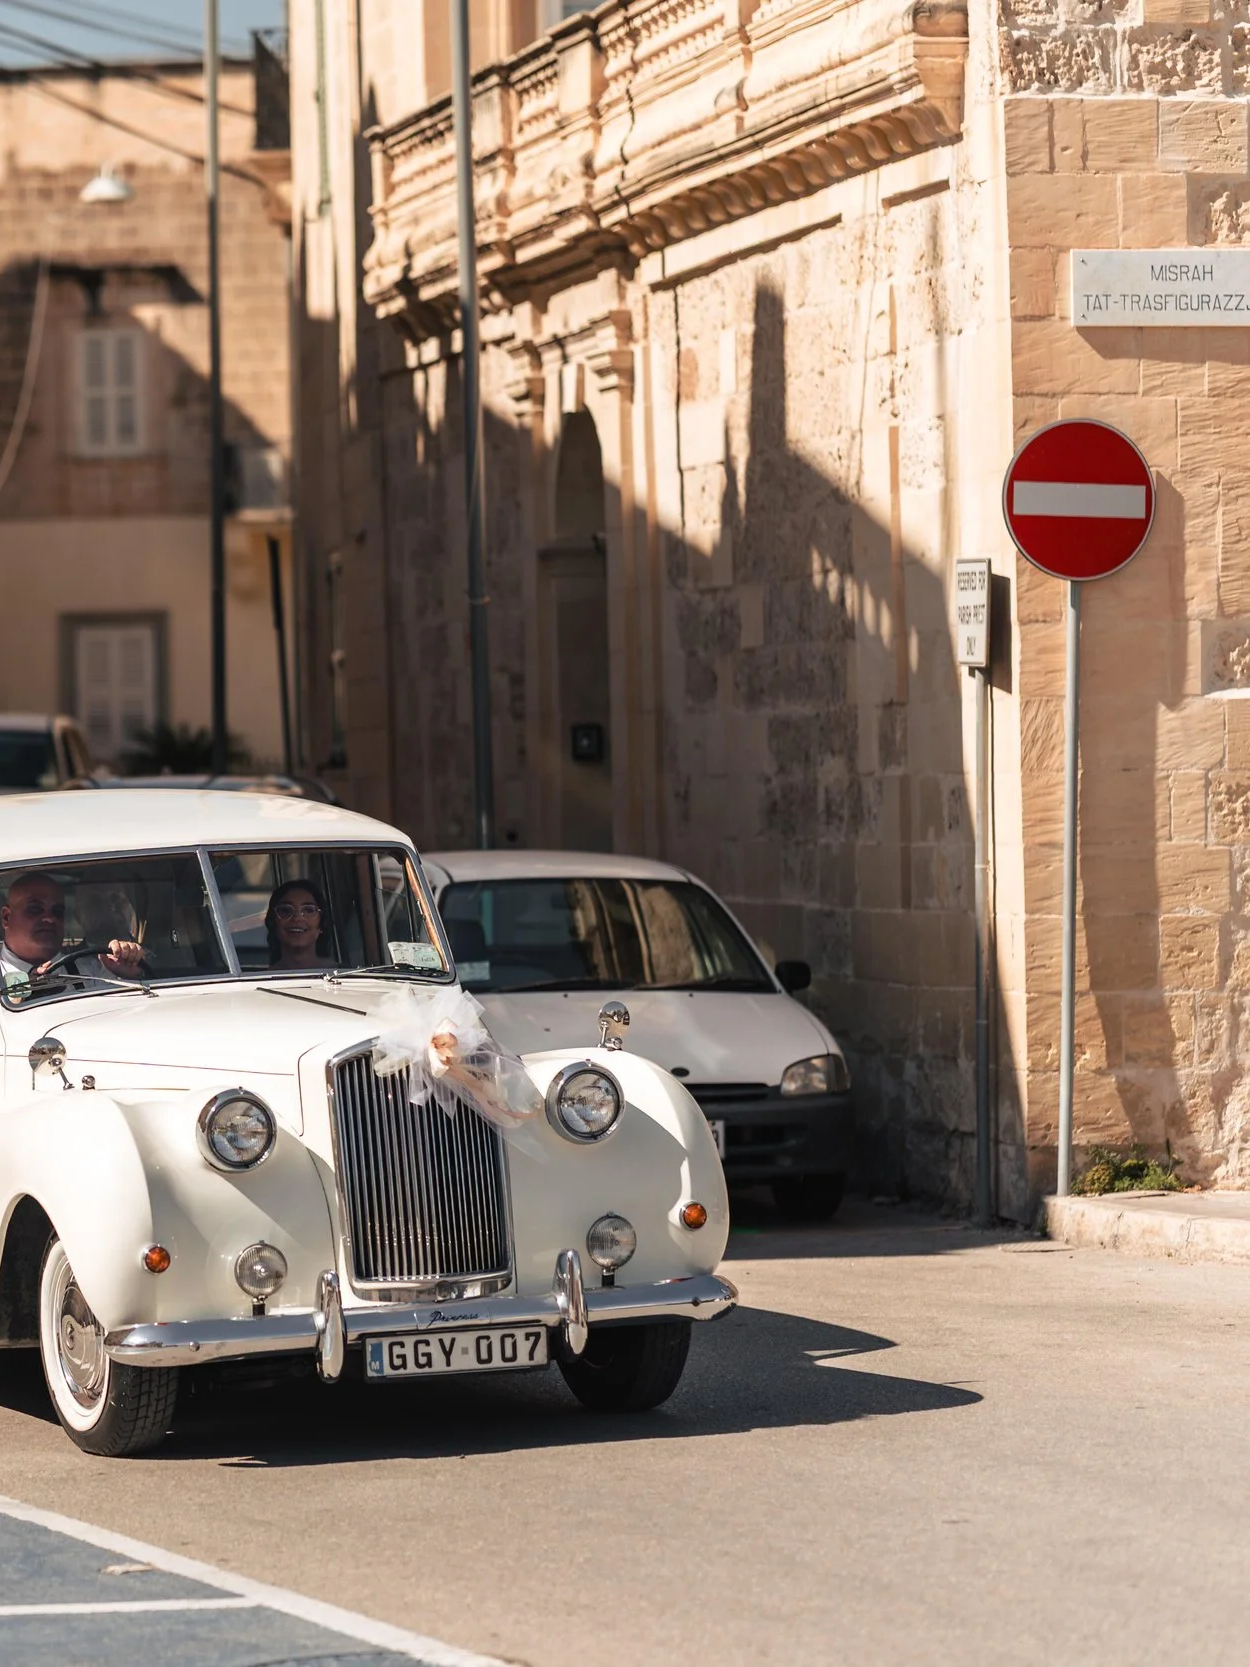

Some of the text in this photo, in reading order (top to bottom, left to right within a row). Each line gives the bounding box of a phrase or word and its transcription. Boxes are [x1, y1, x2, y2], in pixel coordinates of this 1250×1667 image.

[1150, 264, 1214, 282] MISRAH
[426, 1310, 479, 1329] Princess
[388, 1331, 542, 1371] GGY 007
